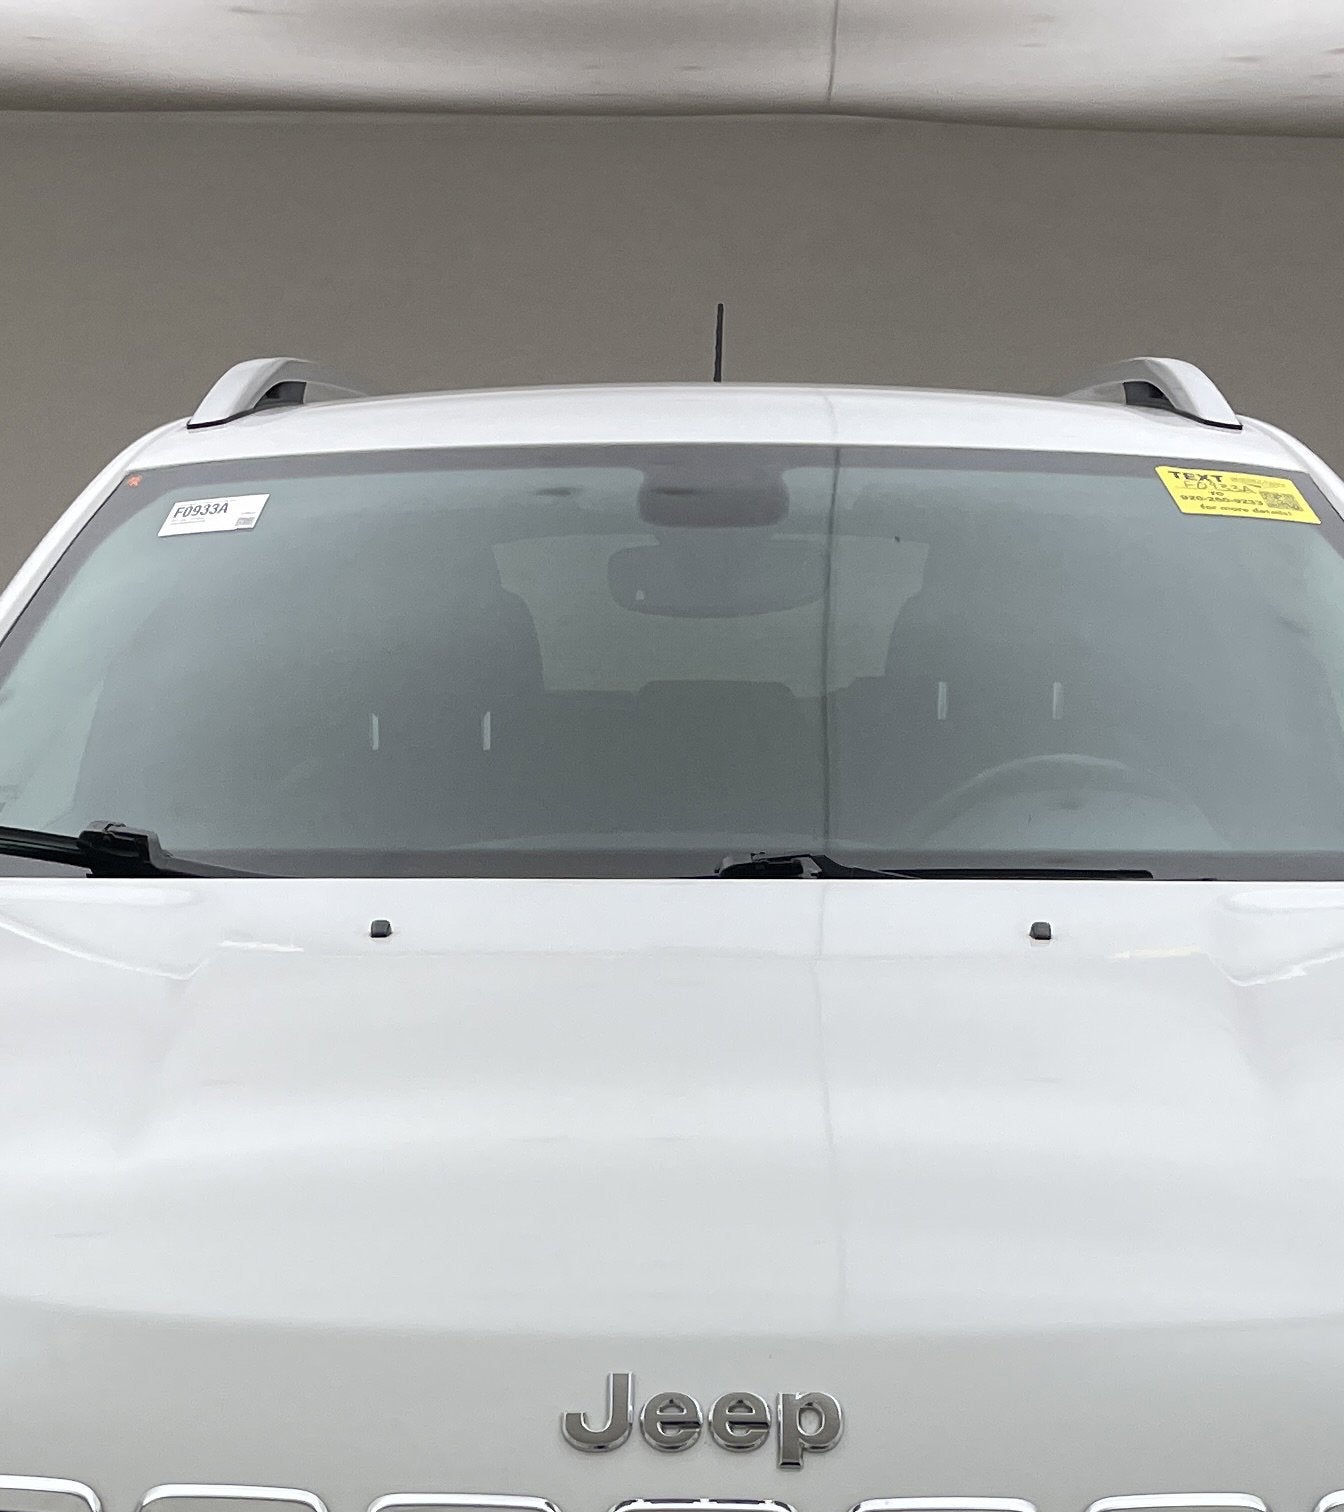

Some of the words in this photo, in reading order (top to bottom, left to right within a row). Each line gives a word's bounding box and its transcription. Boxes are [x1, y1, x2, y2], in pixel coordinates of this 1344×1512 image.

[1168, 471, 1223, 483] TEXT
[173, 502, 229, 518] F0933A
[561, 1372, 846, 1470] Jeep
